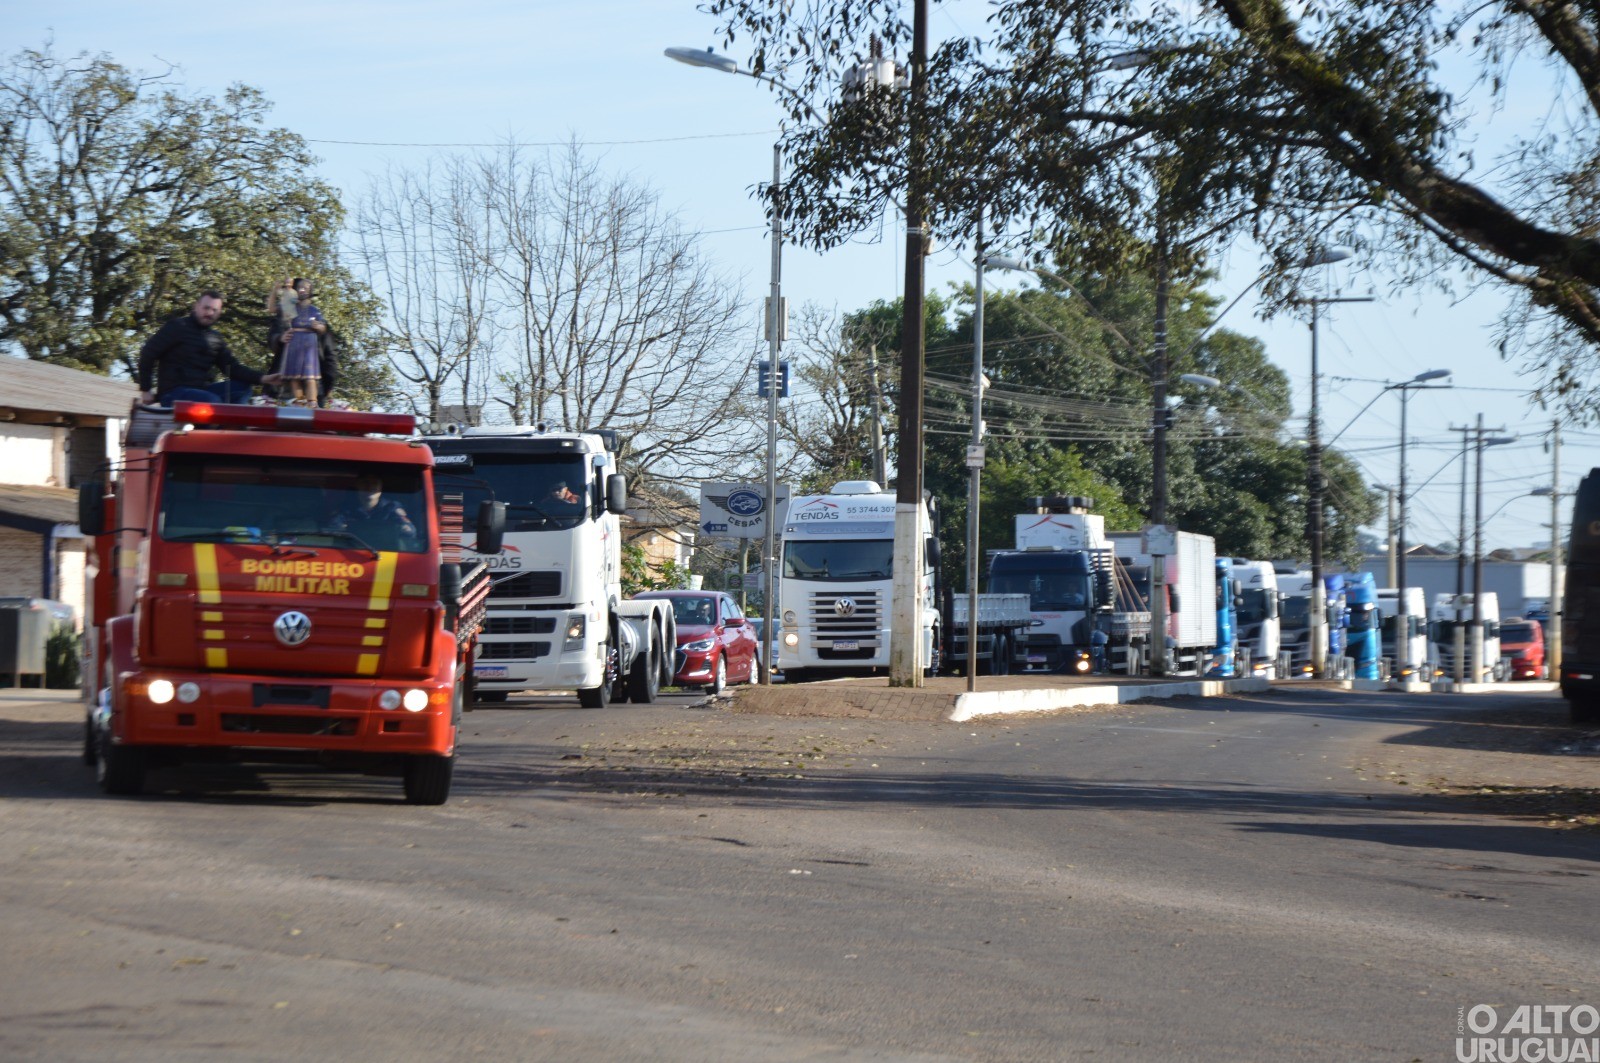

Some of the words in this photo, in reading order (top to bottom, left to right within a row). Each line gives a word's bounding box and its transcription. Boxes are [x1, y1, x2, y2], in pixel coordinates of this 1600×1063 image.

[881, 505, 896, 513] 307
[795, 511, 839, 520] TENDAS
[727, 516, 763, 528] CESAR
[241, 559, 365, 578] BOMBEIRO
[255, 576, 351, 595] MILITAR
